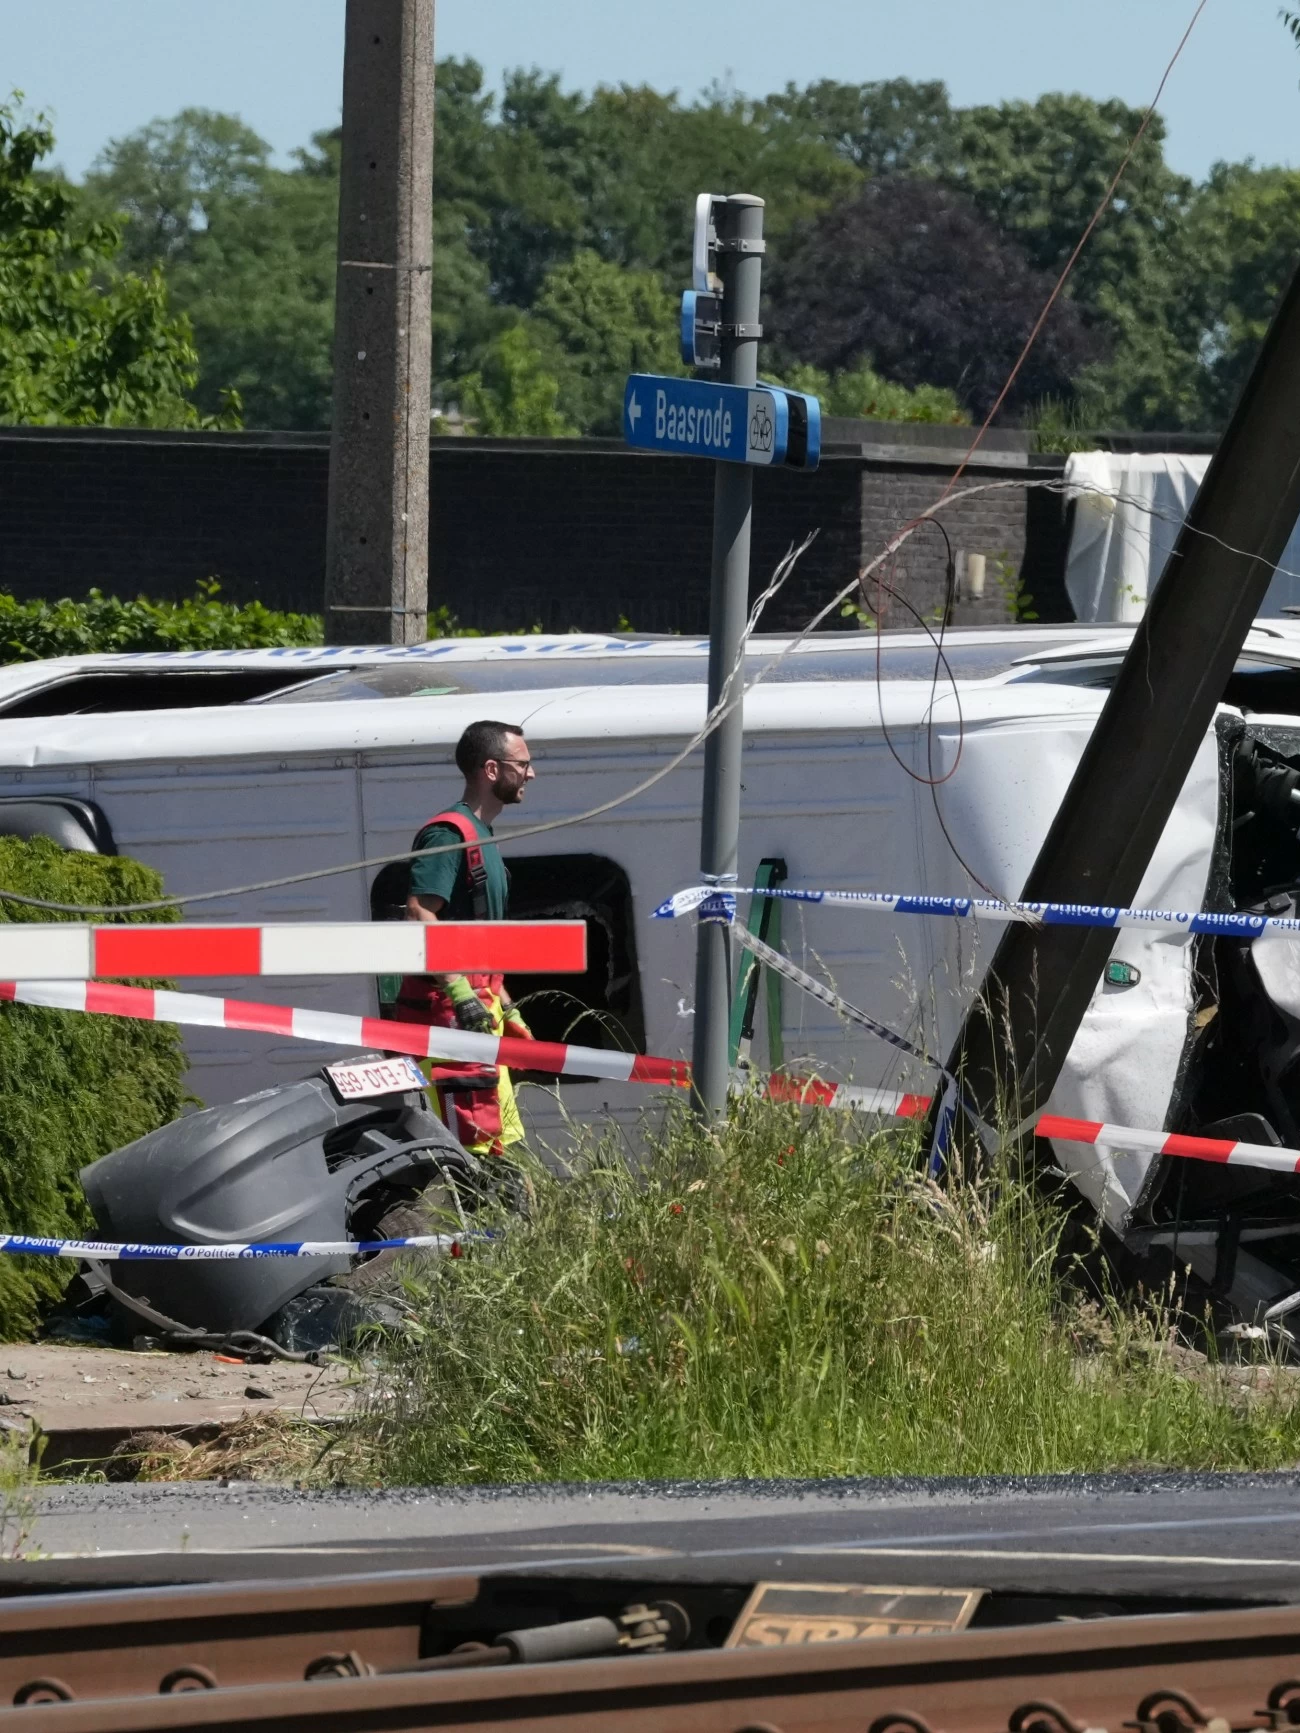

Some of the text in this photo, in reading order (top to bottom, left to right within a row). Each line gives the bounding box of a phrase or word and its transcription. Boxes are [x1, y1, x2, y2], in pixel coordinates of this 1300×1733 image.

[655, 389, 732, 448] Baasrode
[1050, 903, 1099, 917] Politie
[1124, 908, 1172, 921] Politie
[1197, 913, 1246, 927] Politie
[140, 1245, 179, 1257] Politie
[196, 1248, 236, 1259] Politie
